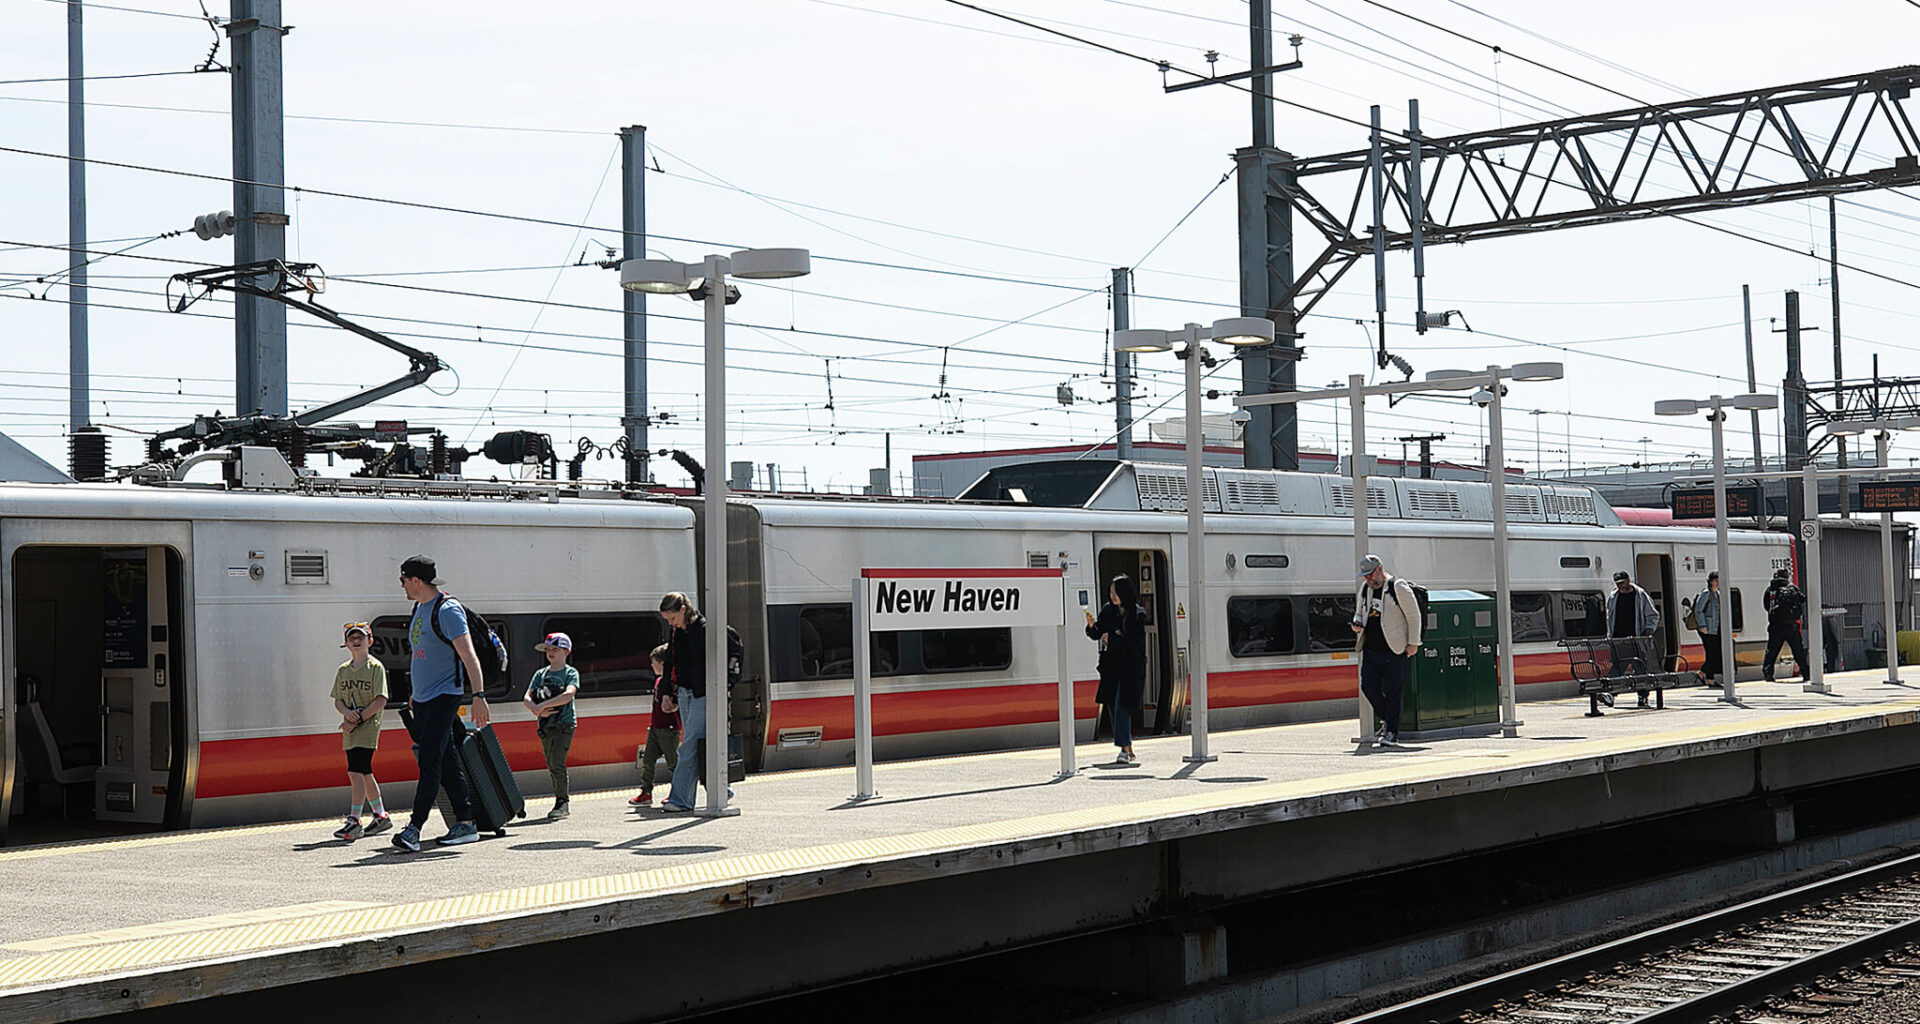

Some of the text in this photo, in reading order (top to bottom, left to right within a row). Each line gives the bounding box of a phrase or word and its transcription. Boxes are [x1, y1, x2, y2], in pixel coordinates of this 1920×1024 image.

[876, 581, 1021, 613] New Haven
[1424, 647, 1438, 657] Trash
[1449, 646, 1466, 656] Bottles
[1479, 644, 1492, 653] Trash
[1449, 656, 1467, 667] & Cans
[340, 679, 371, 690] SAINTS
